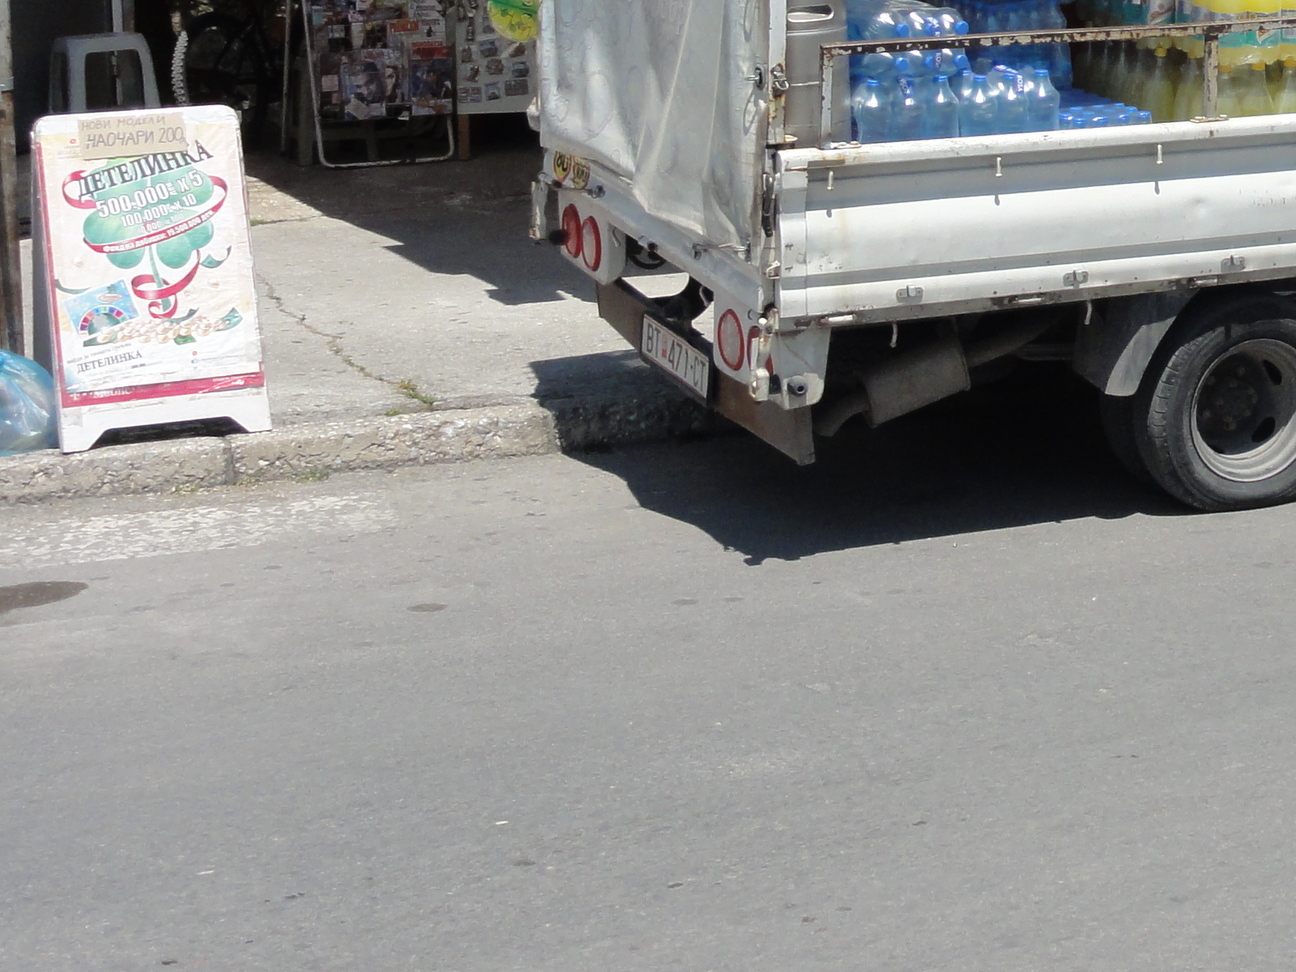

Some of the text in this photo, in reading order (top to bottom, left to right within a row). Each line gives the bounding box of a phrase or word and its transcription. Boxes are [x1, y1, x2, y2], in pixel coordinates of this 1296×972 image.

[81, 115, 166, 132] НОВИ МОДЕЛИ
[86, 129, 155, 149] НАОЧАРИ
[77, 139, 214, 203] ДЕТЕЛИНКА
[95, 182, 170, 219] 500.000
[187, 169, 204, 188] 5
[182, 193, 197, 207] 10
[646, 322, 661, 358] BT
[77, 350, 142, 374] ДЕТЕЛИНКА
